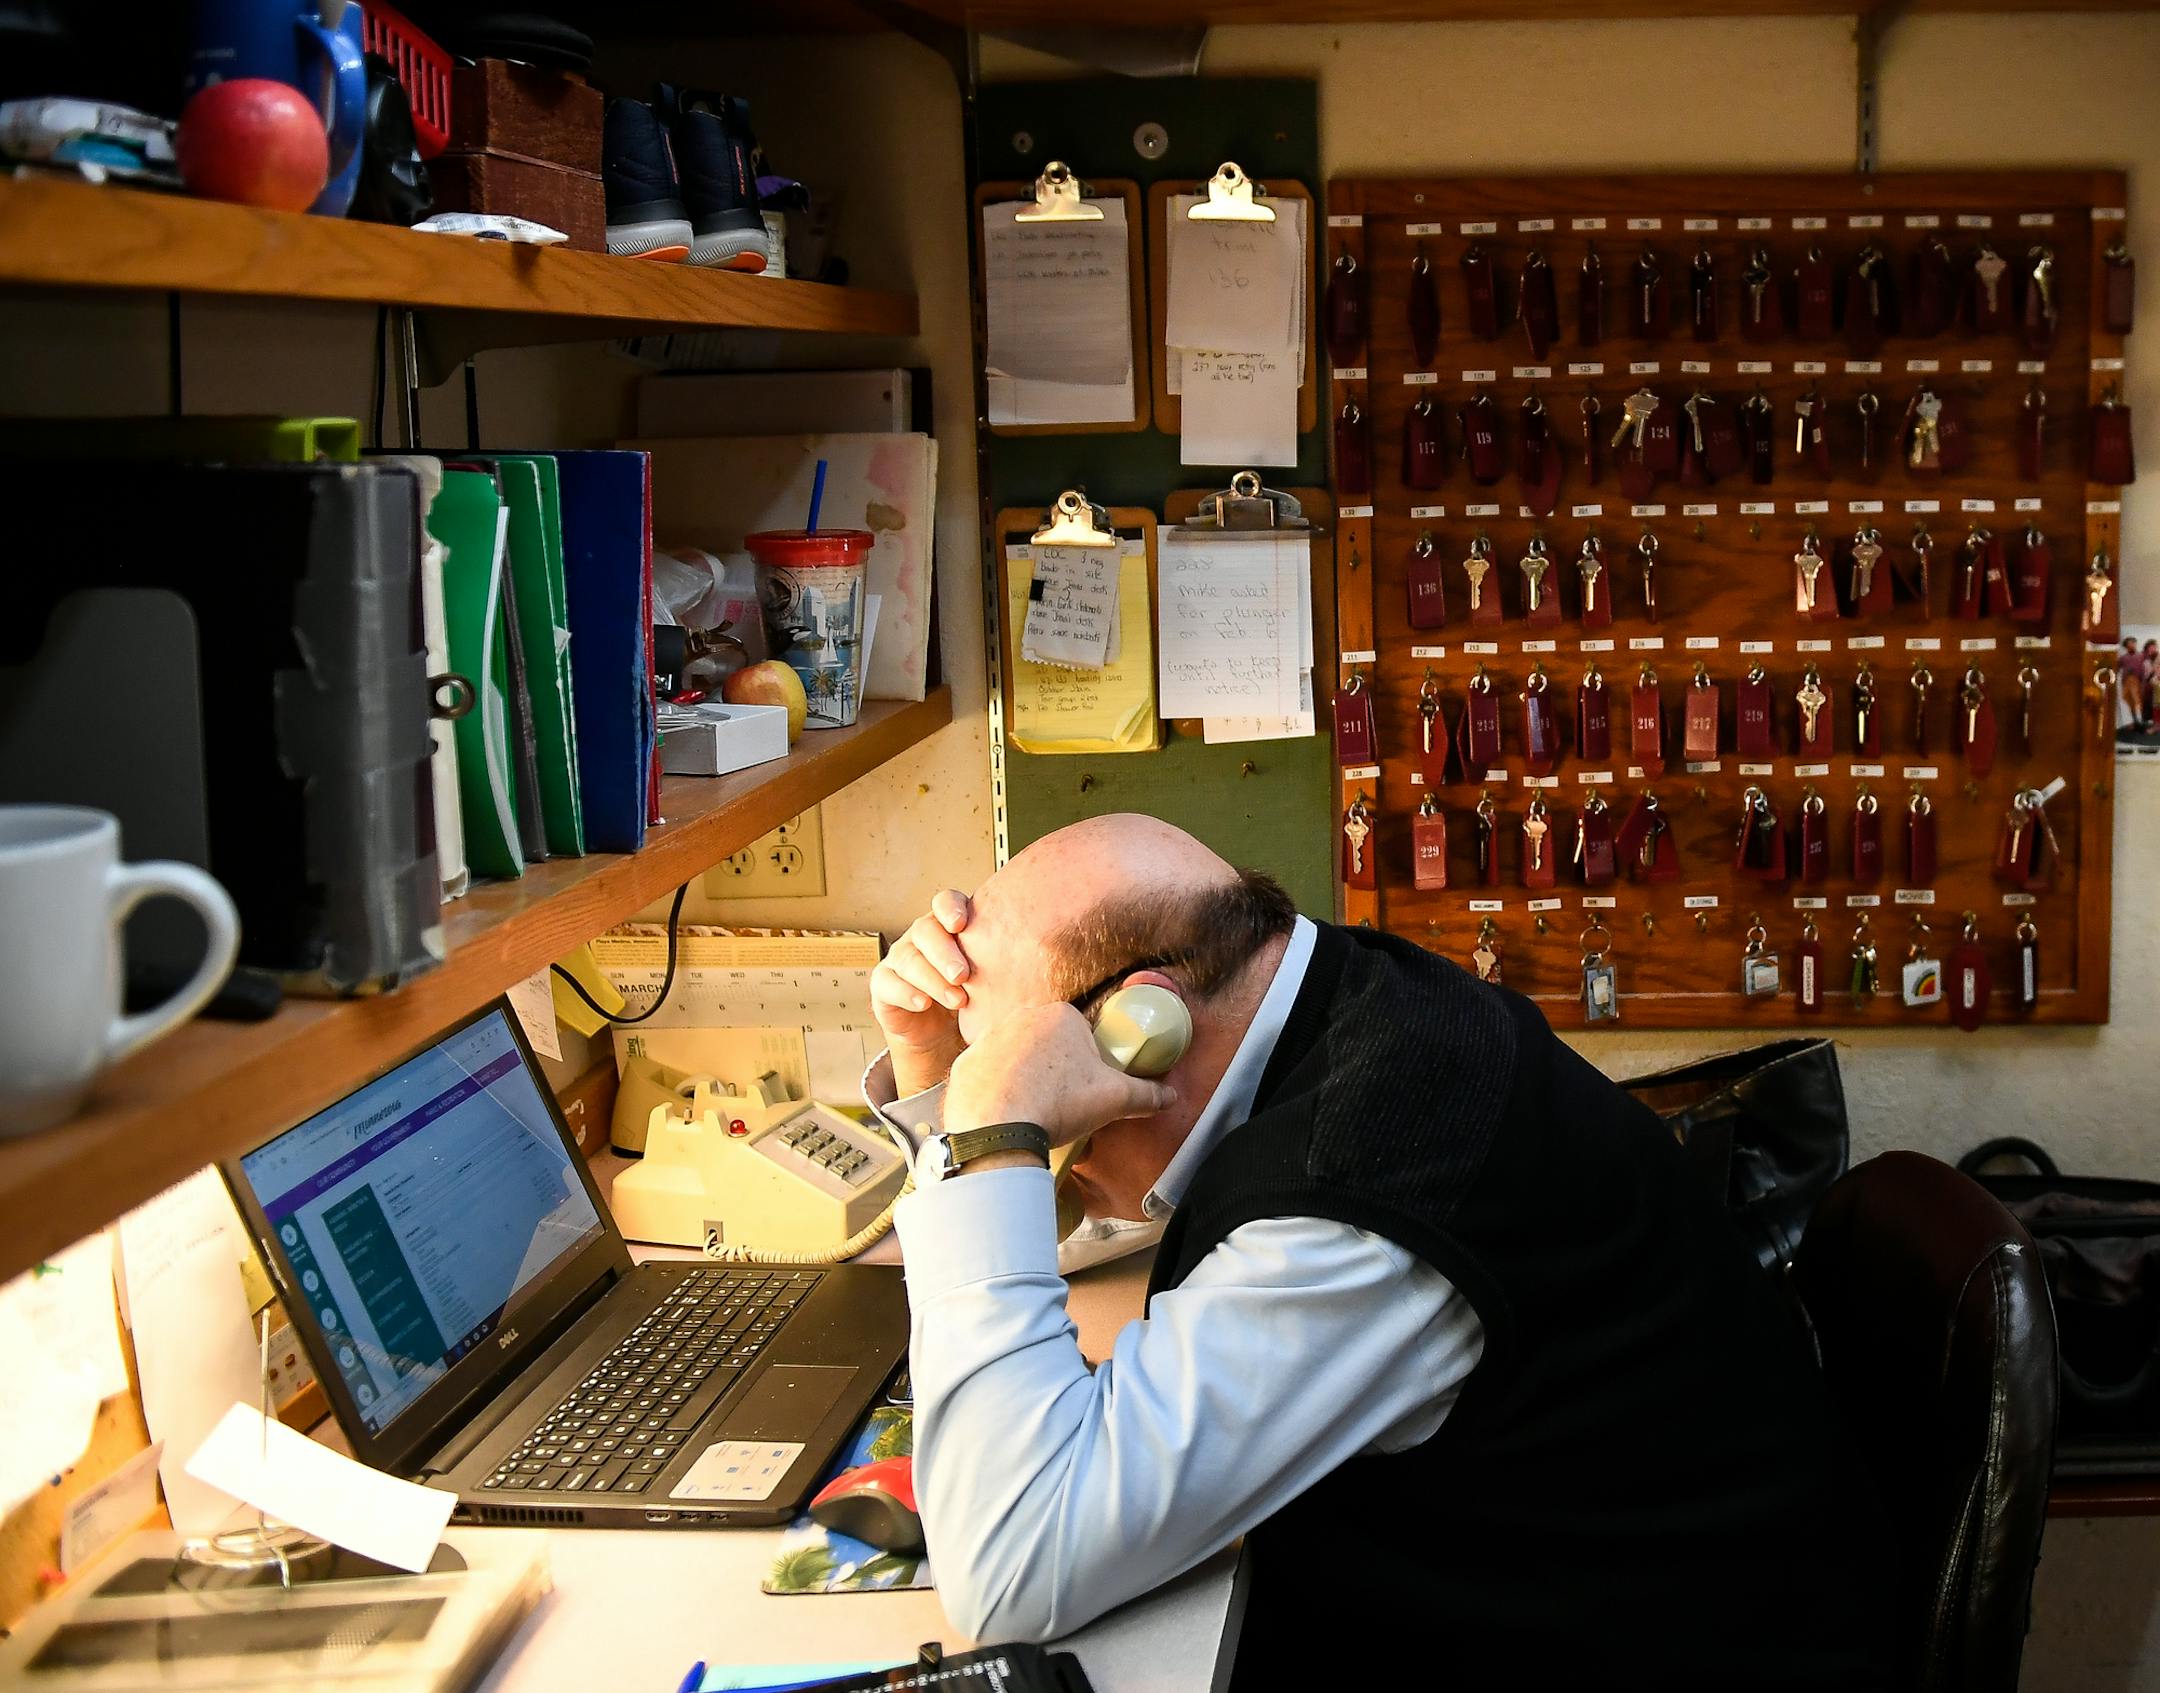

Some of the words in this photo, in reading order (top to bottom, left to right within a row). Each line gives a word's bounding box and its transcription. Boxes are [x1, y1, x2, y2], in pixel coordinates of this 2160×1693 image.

[1418, 441, 1436, 455] 117
[1417, 582, 1437, 596] 136
[1744, 709, 1764, 723] 219
[1342, 719, 1362, 734] 211
[1476, 719, 1495, 732] 213
[1589, 716, 1607, 731] 215
[1637, 717, 1655, 731] 216
[1692, 717, 1711, 731] 217
[1420, 845, 1440, 859] 229
[618, 984, 663, 993] MARCH
[800, 1002, 806, 1010] 8
[802, 1025, 813, 1033] 15
[841, 1024, 852, 1032] 16
[499, 1327, 520, 1350] DELL
